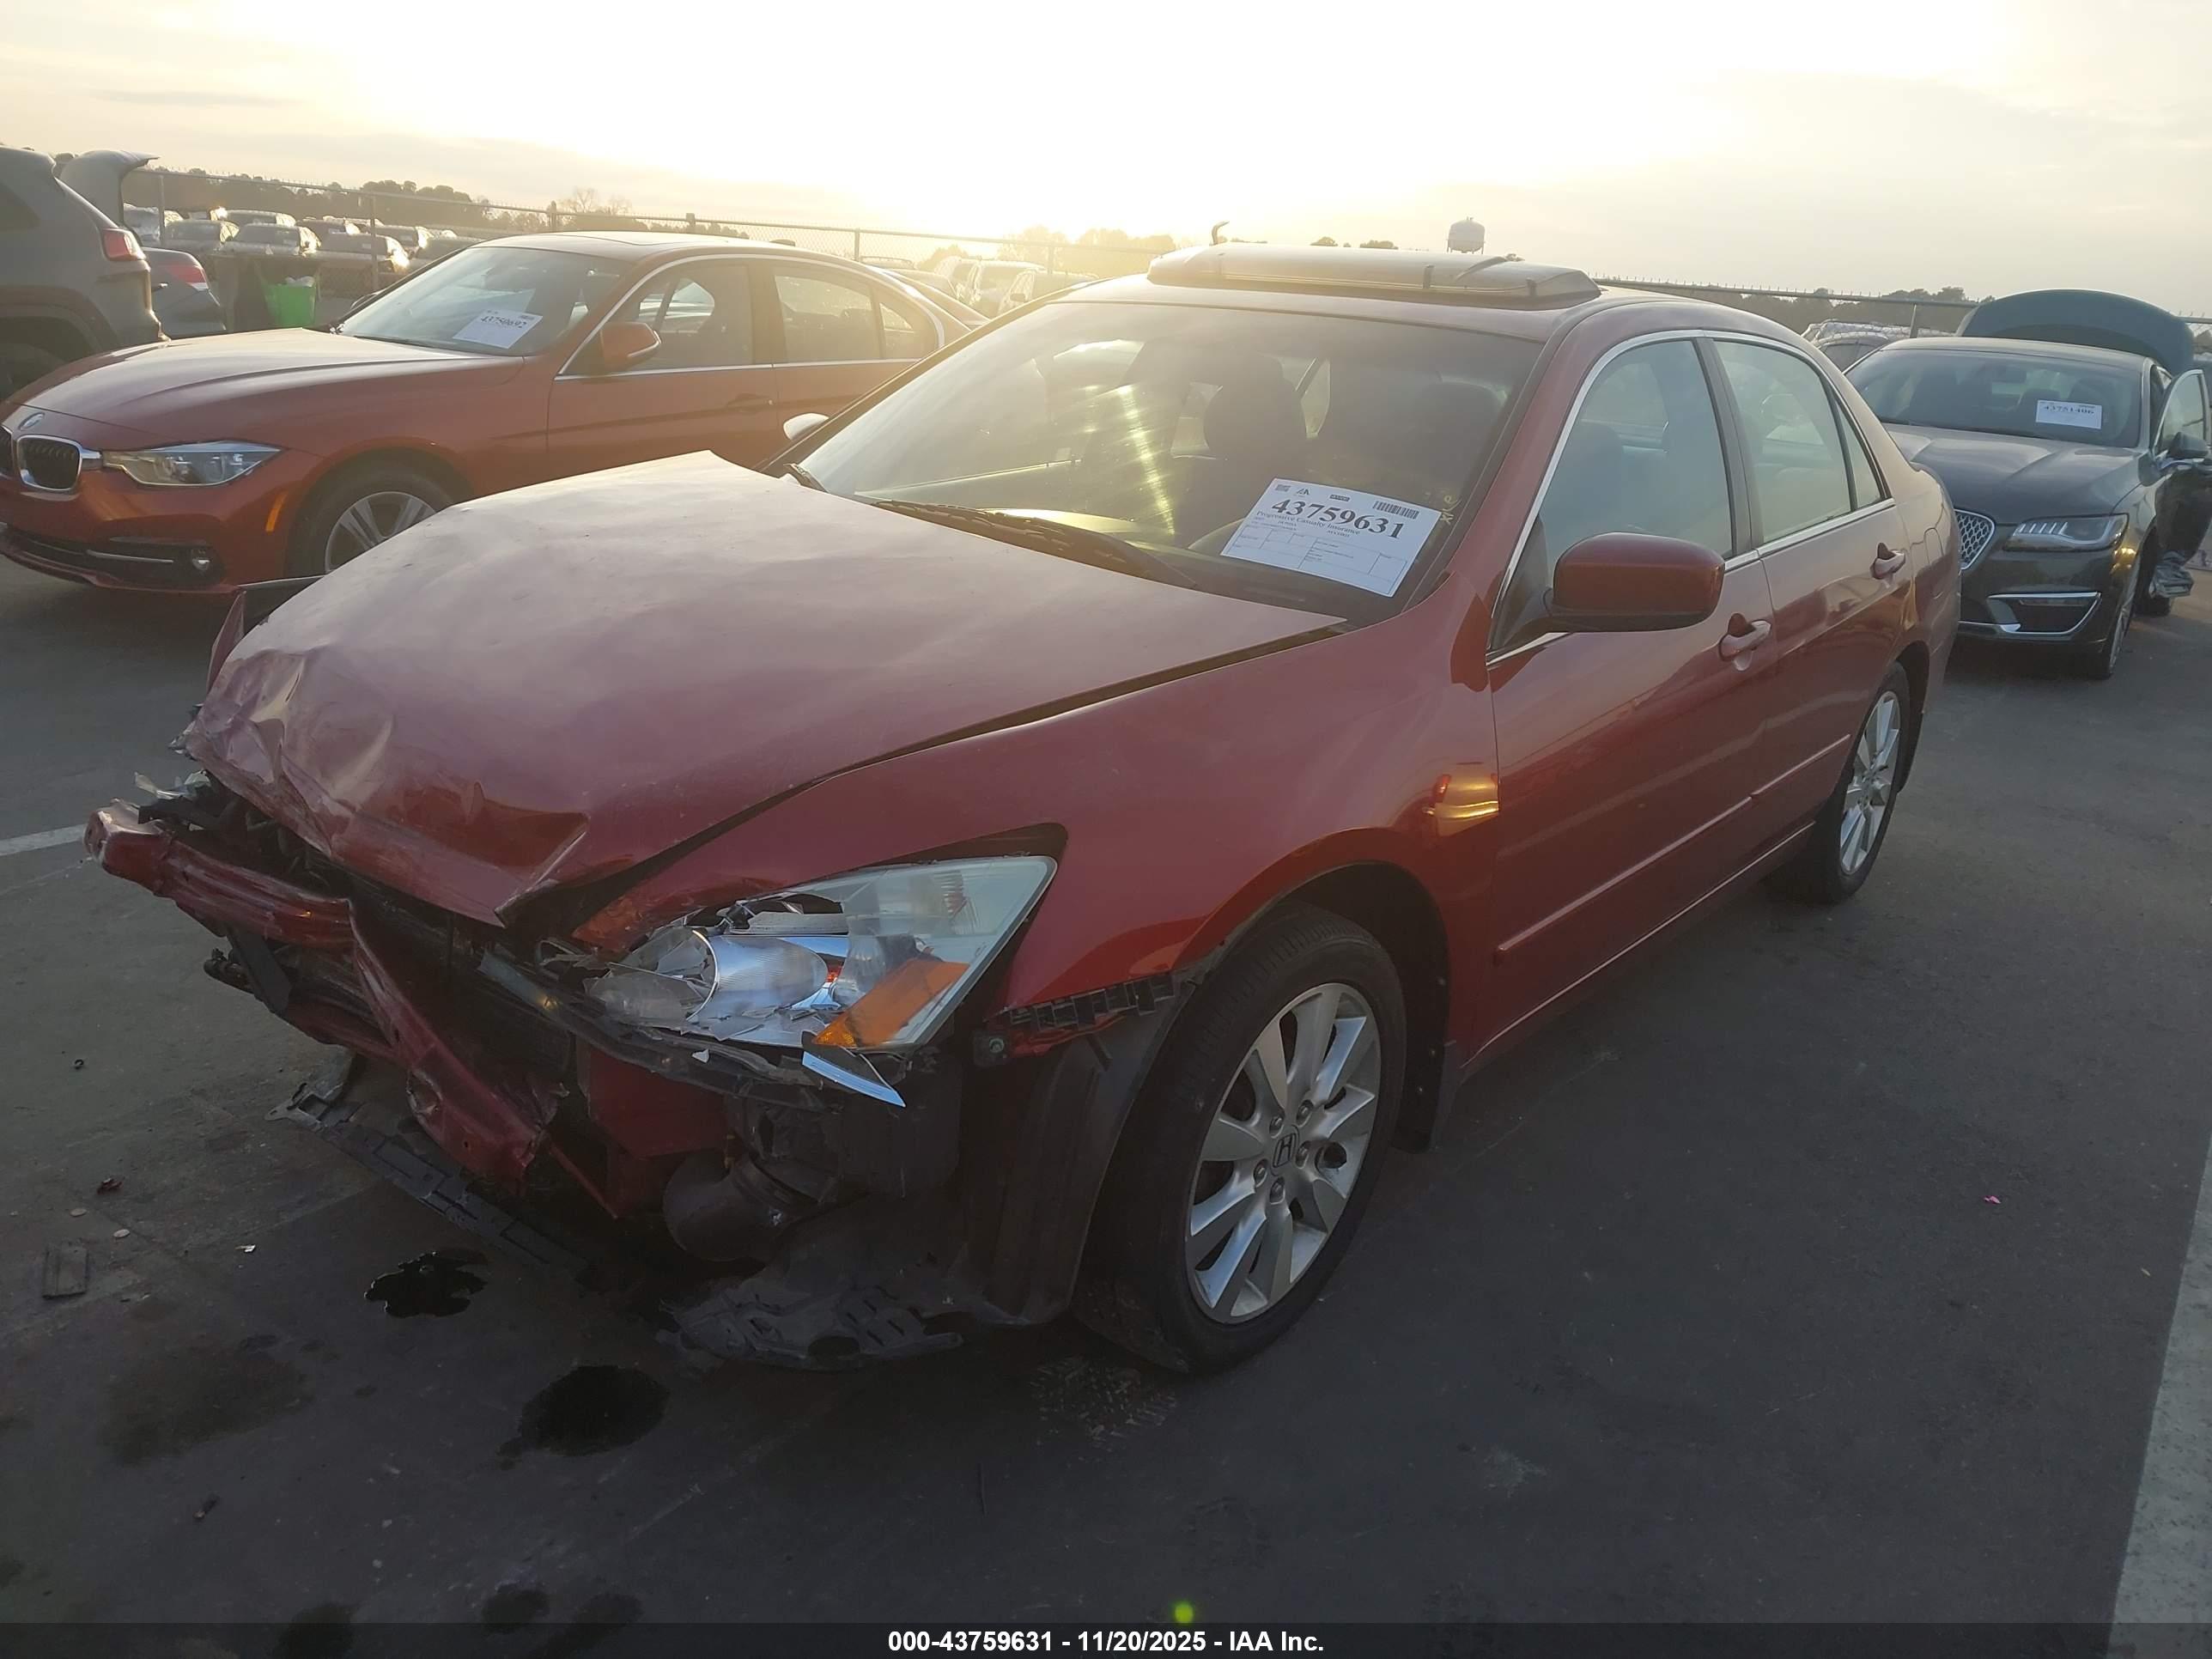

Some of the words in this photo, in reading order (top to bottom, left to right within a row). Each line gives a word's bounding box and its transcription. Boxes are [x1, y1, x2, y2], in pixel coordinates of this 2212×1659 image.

[1256, 510, 1294, 521] Progressive
[1297, 517, 1325, 527] Casualty
[1327, 522, 1361, 535] Insurance
[1272, 499, 1405, 539] 43759631
